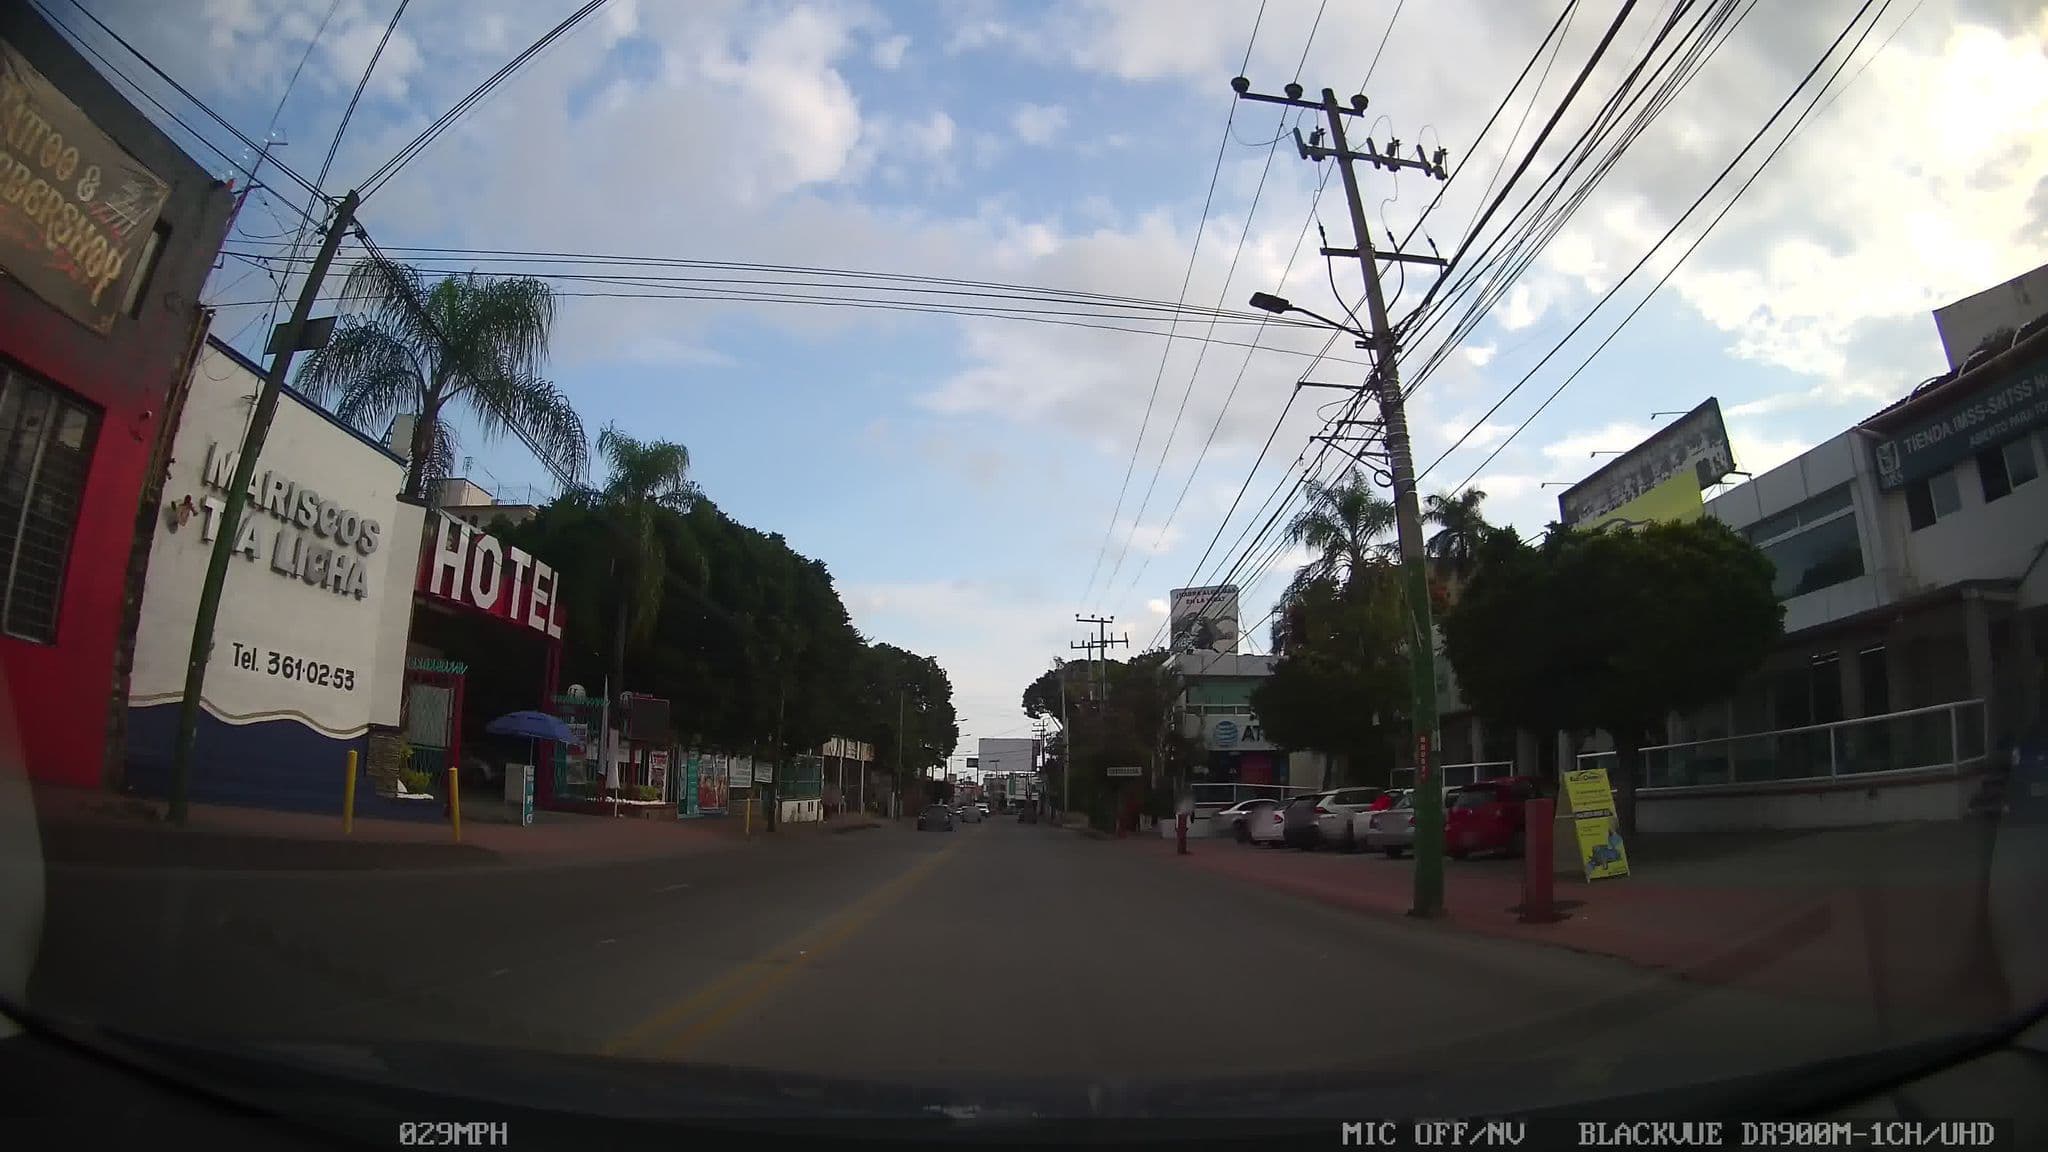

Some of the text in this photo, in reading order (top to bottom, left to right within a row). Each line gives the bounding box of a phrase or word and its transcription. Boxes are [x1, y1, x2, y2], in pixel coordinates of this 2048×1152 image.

[1903, 420, 1951, 455] TIENDA
[202, 494, 262, 561] TA
[203, 440, 380, 555] MARISCOS
[429, 515, 562, 640] HOTEL
[232, 641, 260, 673] Tel.
